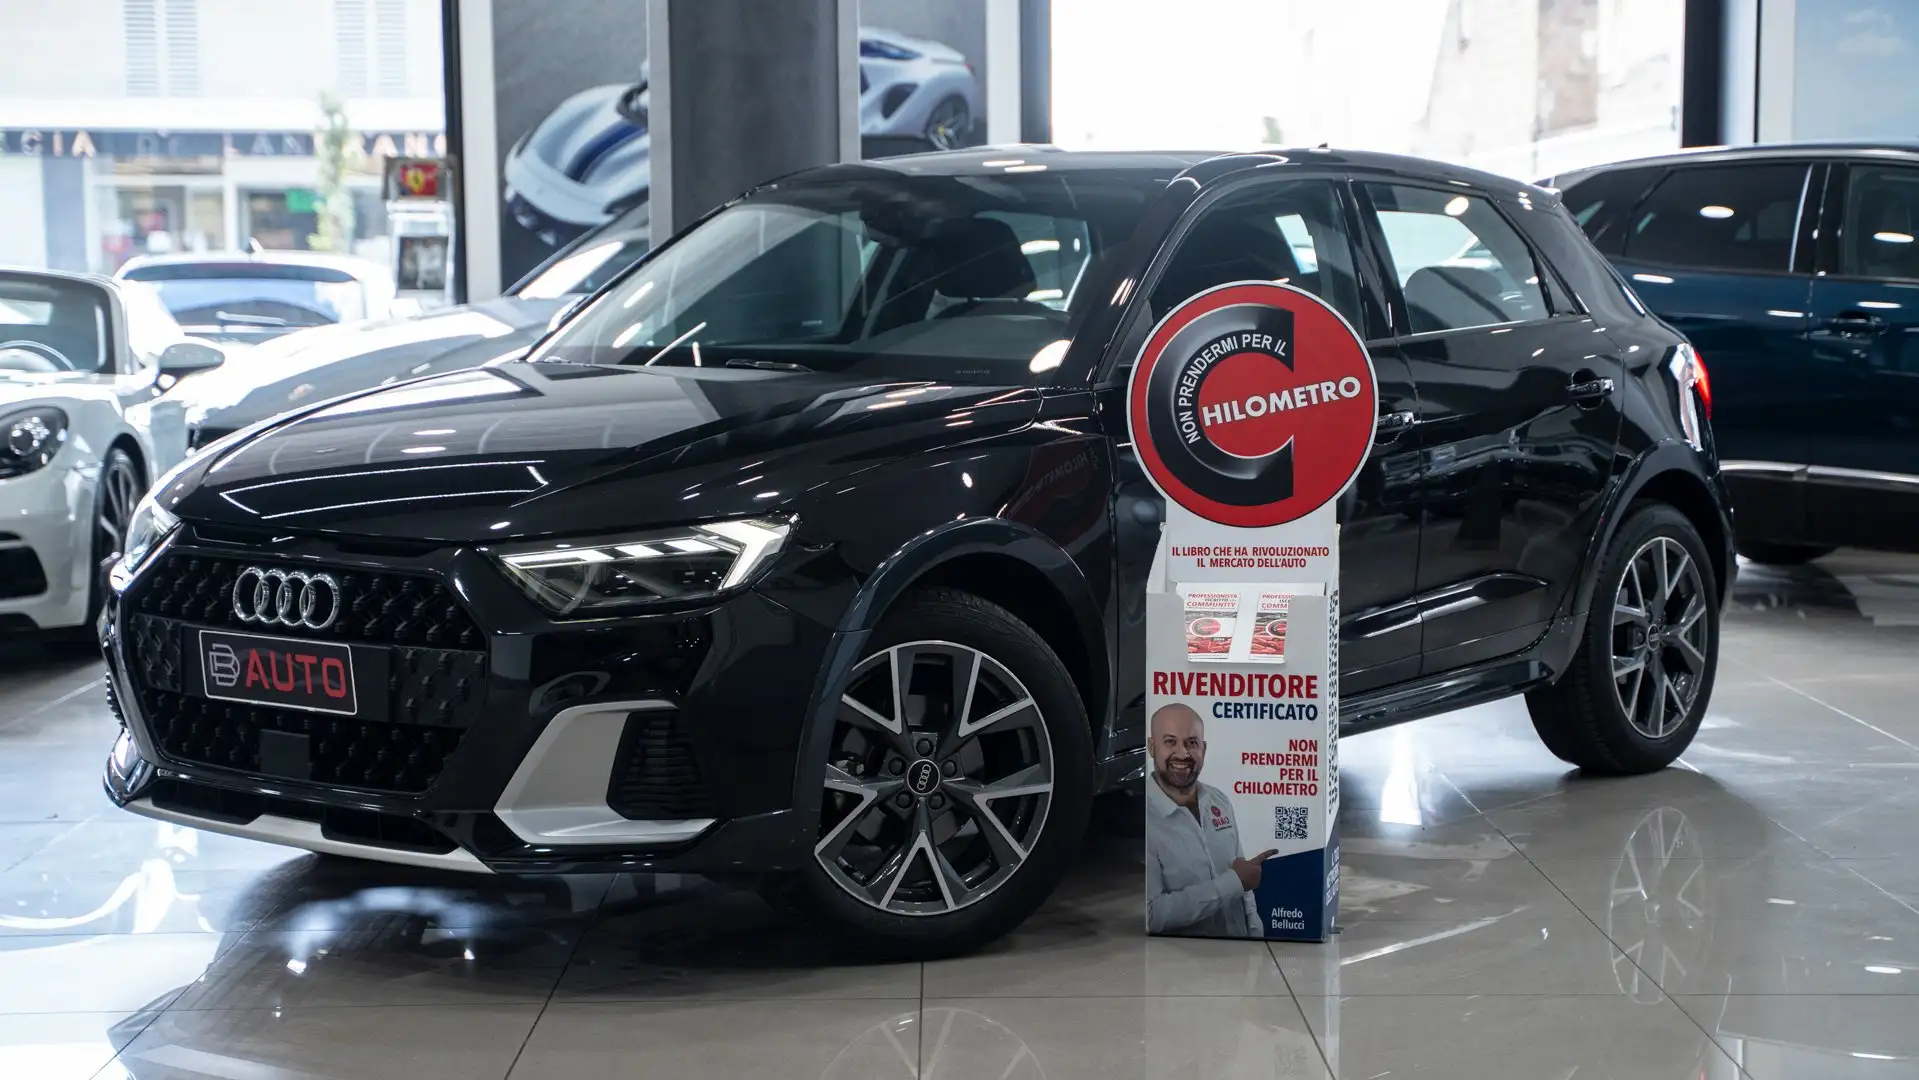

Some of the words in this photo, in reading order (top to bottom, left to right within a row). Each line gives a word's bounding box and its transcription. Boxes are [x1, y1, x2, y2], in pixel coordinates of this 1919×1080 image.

[1242, 333, 1272, 350] PER
[1274, 339, 1288, 357] IL
[1178, 335, 1239, 407] PRENDERMI
[1179, 410, 1201, 445] NON
[1171, 546, 1181, 557] IL
[1182, 546, 1211, 557] LIBRO
[1213, 546, 1232, 557] CHE
[1234, 547, 1248, 557] HA
[1252, 546, 1330, 557] RIVOLUZIONATO
[1196, 557, 1206, 568] IL
[1209, 557, 1255, 568] MERCATO
[245, 648, 347, 699] AUTO
[1153, 671, 1318, 699] RIVENDITORE
[1212, 701, 1318, 721] CERTIFICATO
[1289, 739, 1318, 753] NON
[1241, 752, 1318, 767] PRENDERMI
[1279, 768, 1304, 781] PER
[1307, 769, 1319, 781] IL
[1234, 781, 1318, 796] CHILOMETRO
[1271, 907, 1303, 919] Alfredo
[1271, 919, 1305, 931] Bellucci
